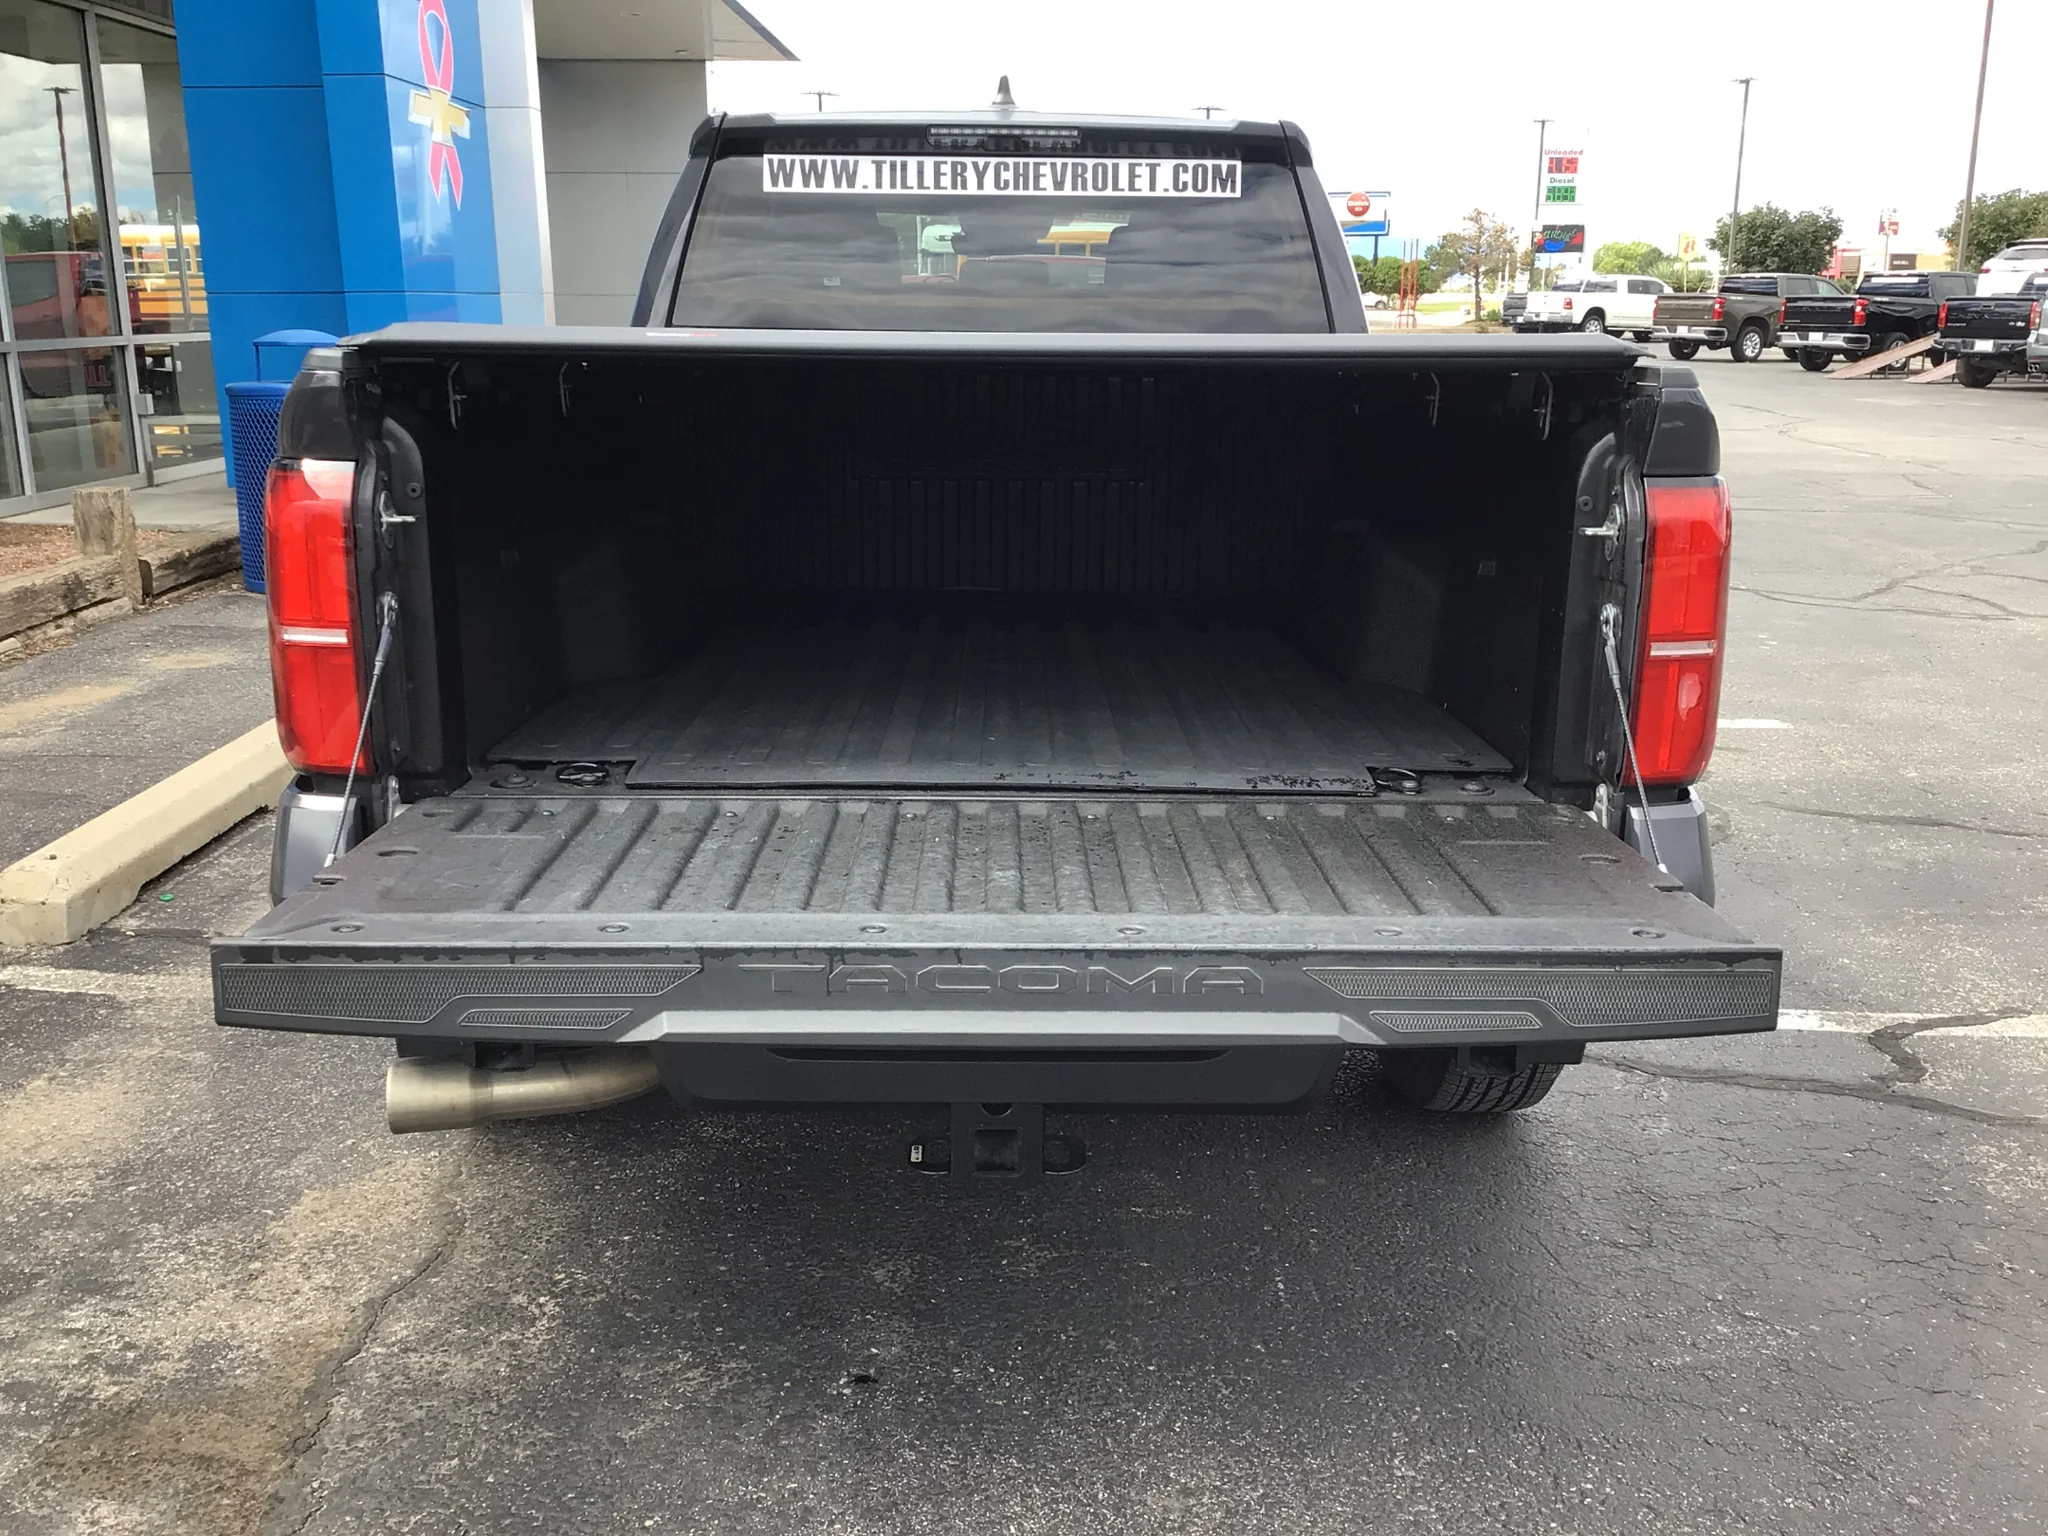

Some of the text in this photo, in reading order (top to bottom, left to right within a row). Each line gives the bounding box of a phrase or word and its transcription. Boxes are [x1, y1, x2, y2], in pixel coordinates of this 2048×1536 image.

[1544, 148, 1584, 156] Unleaded
[767, 157, 1238, 194] WWW.TILLERYCHEVROLET.COM
[738, 964, 1264, 995] TACOMA
